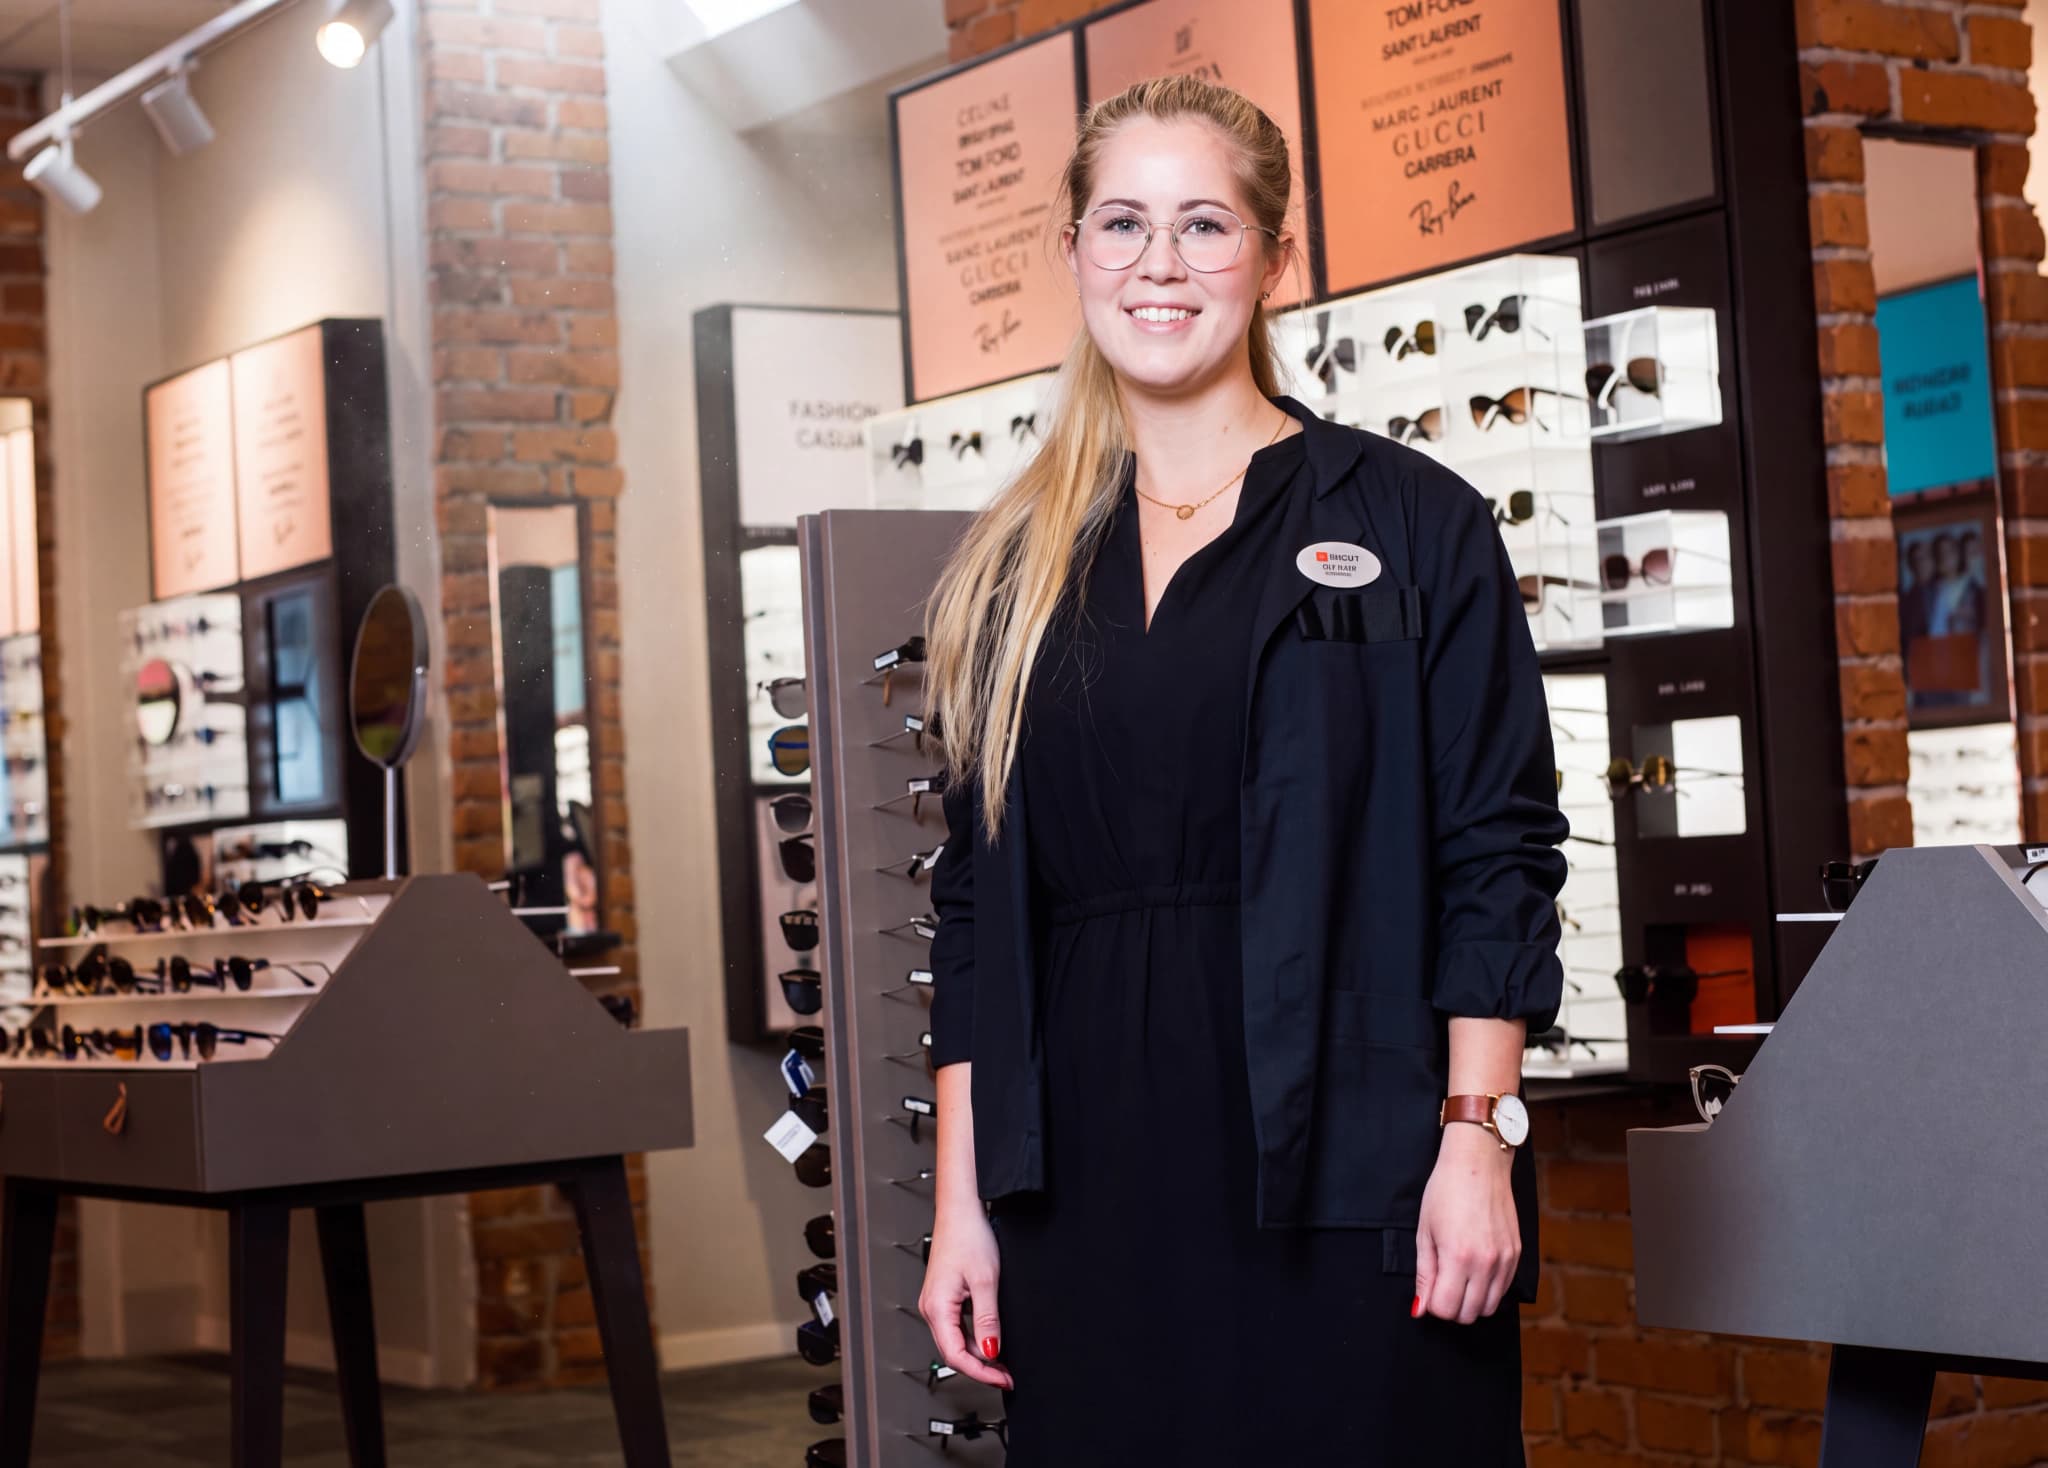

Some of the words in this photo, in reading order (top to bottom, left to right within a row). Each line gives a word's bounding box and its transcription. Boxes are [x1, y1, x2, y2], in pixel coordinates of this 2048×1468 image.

[1385, 1, 1424, 31] TOM
[1381, 34, 1417, 61] SAINT
[1419, 13, 1482, 49] LAURENT
[1372, 105, 1421, 133] MARC
[1392, 110, 1486, 157] GUCCI
[1404, 145, 1477, 179] CARRERA
[960, 250, 1029, 288] GUCCI
